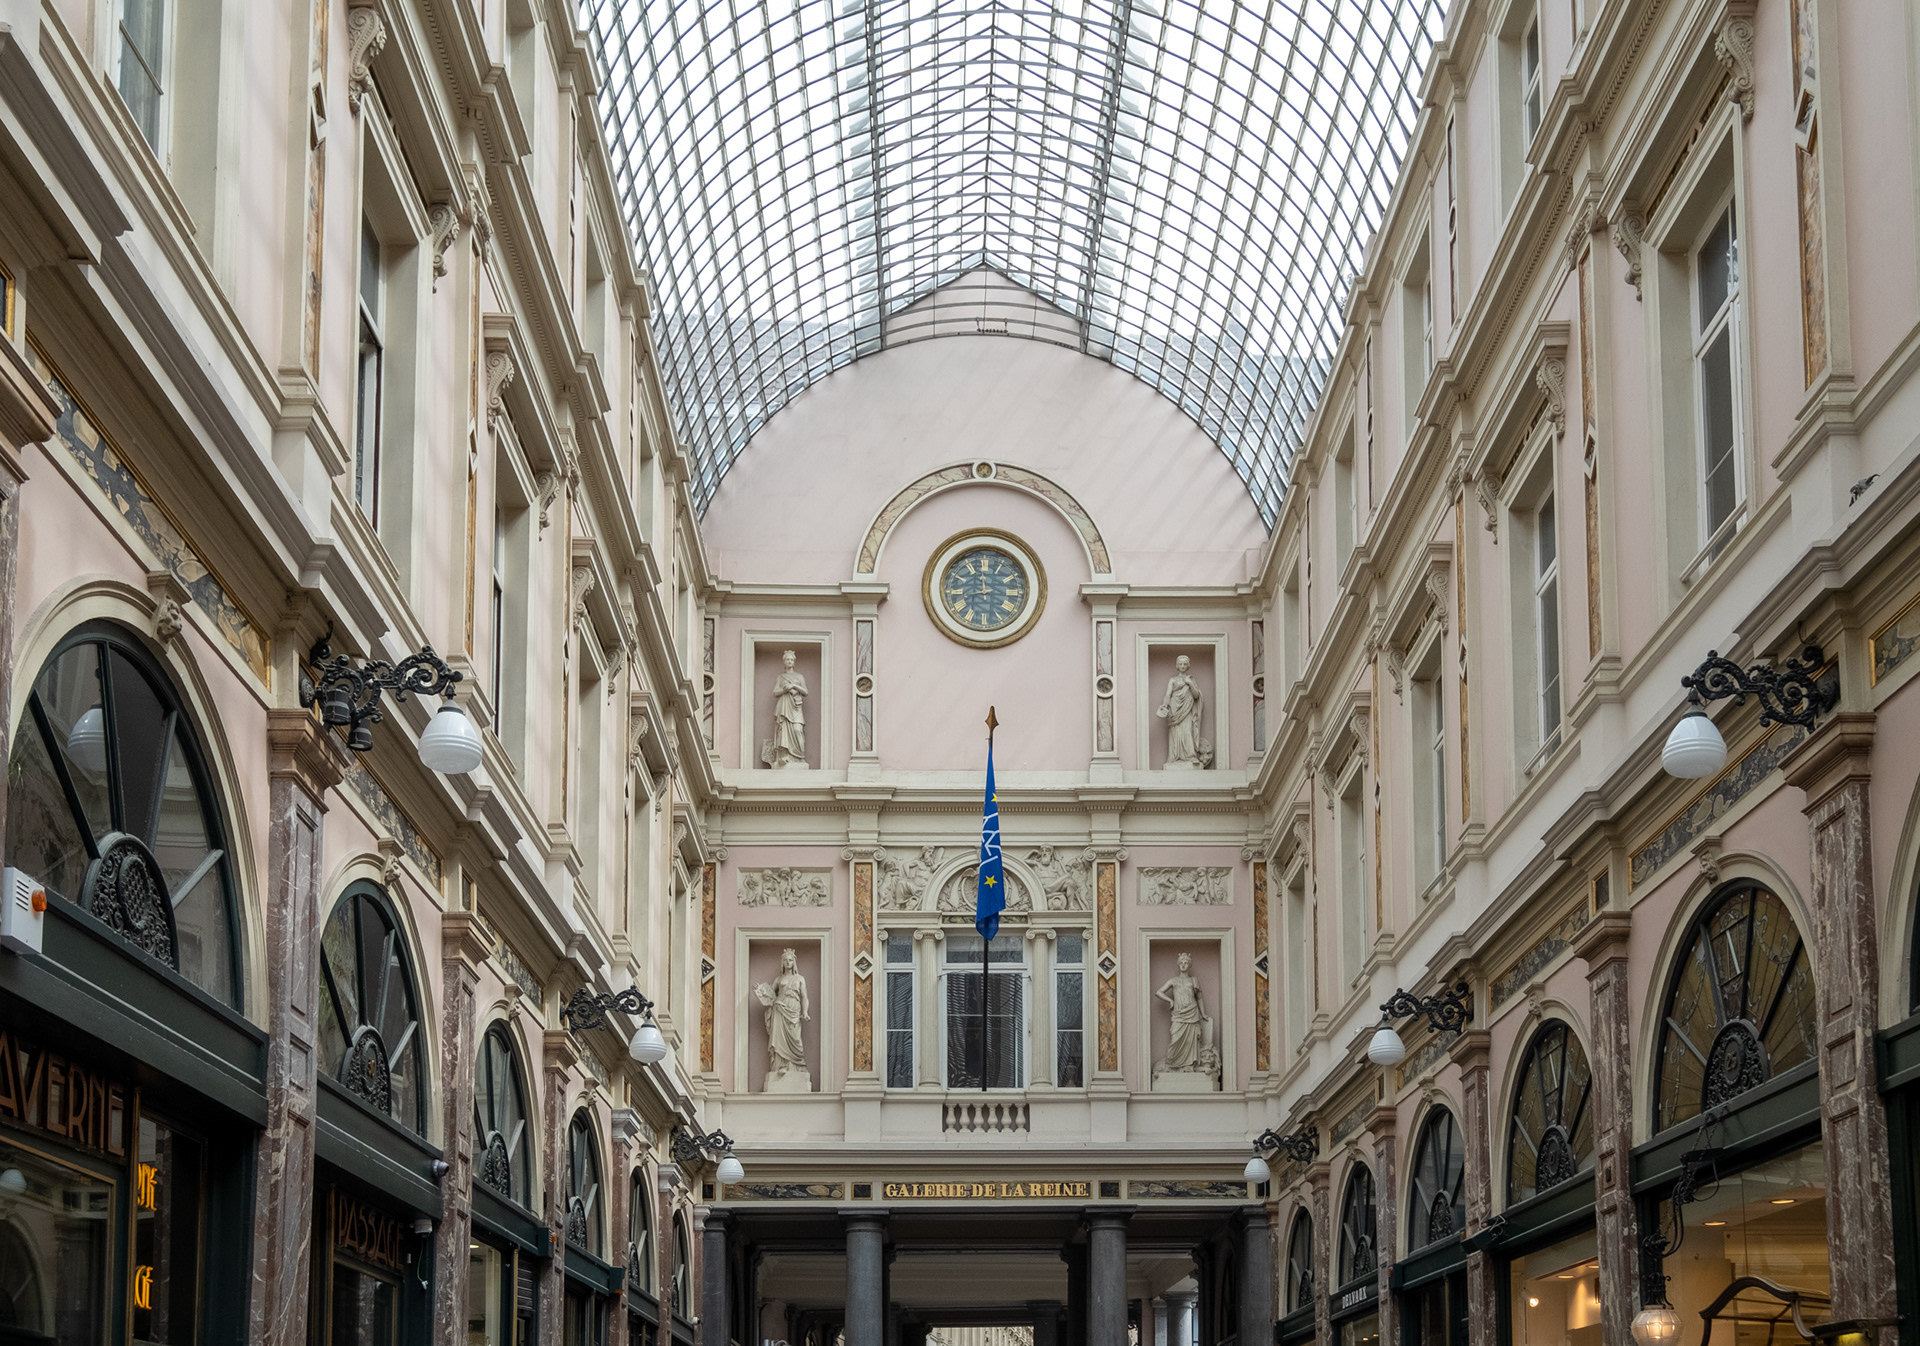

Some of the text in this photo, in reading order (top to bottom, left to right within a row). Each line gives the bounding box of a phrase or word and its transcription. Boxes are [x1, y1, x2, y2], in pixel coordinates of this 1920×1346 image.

[885, 1183, 967, 1198] GALERIE
[970, 1183, 996, 1197] DE
[1000, 1183, 1025, 1197] LA
[338, 1193, 404, 1271] PASSAGE
[1341, 1286, 1367, 1309] DELVAUX
